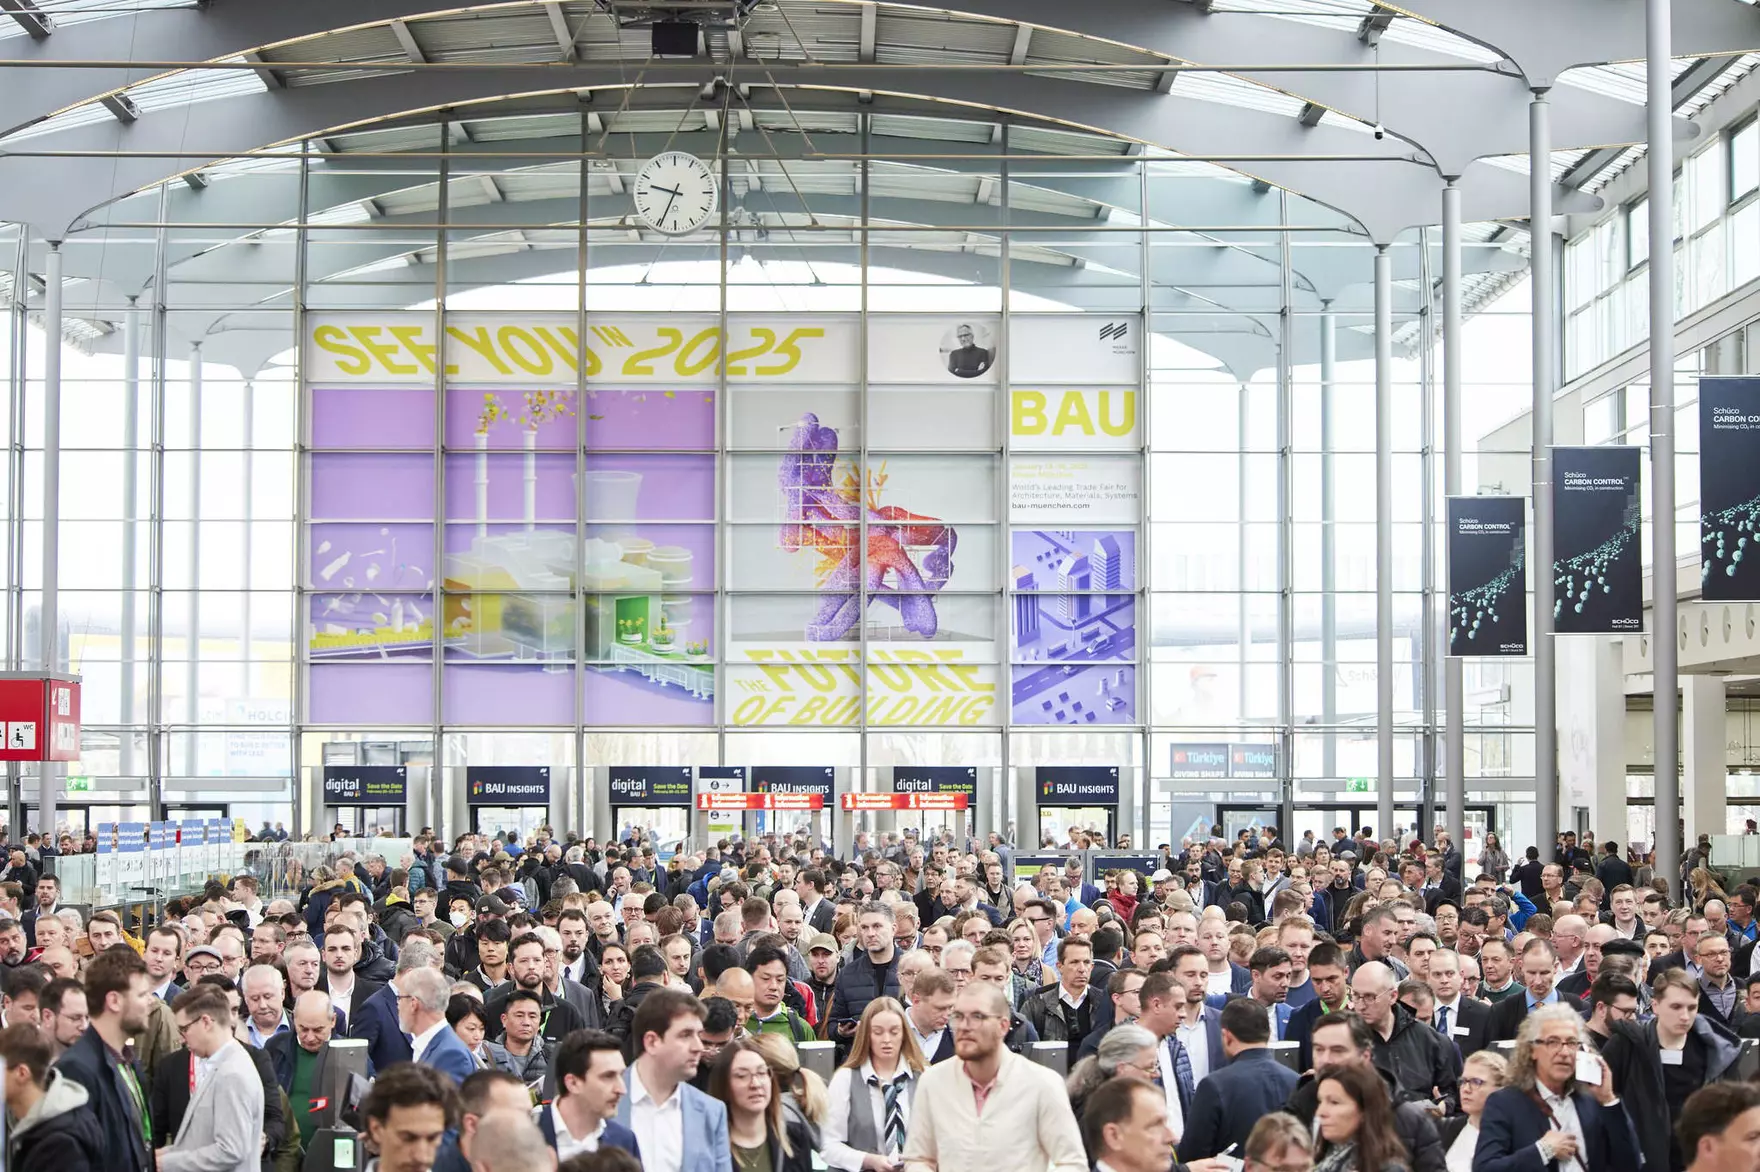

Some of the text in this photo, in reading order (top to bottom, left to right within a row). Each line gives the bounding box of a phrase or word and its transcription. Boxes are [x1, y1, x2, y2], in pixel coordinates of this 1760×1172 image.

[313, 325, 825, 377] SEE YOU IN 2025
[1012, 390, 1135, 437] BAU
[1713, 415, 1747, 423] CARBON
[1043, 484, 1074, 493] Leading
[734, 650, 996, 692] THE FUTURE
[732, 696, 995, 725] OF BUILDING
[1187, 752, 1225, 765] Türkiye
[326, 779, 360, 793] digital
[485, 783, 545, 793] BAU INSIGHTS
[611, 779, 646, 793] digital
[771, 783, 830, 793] BAU INSIGHTS
[896, 779, 932, 792] digital
[1057, 783, 1115, 793] BAU INSIGHTS
